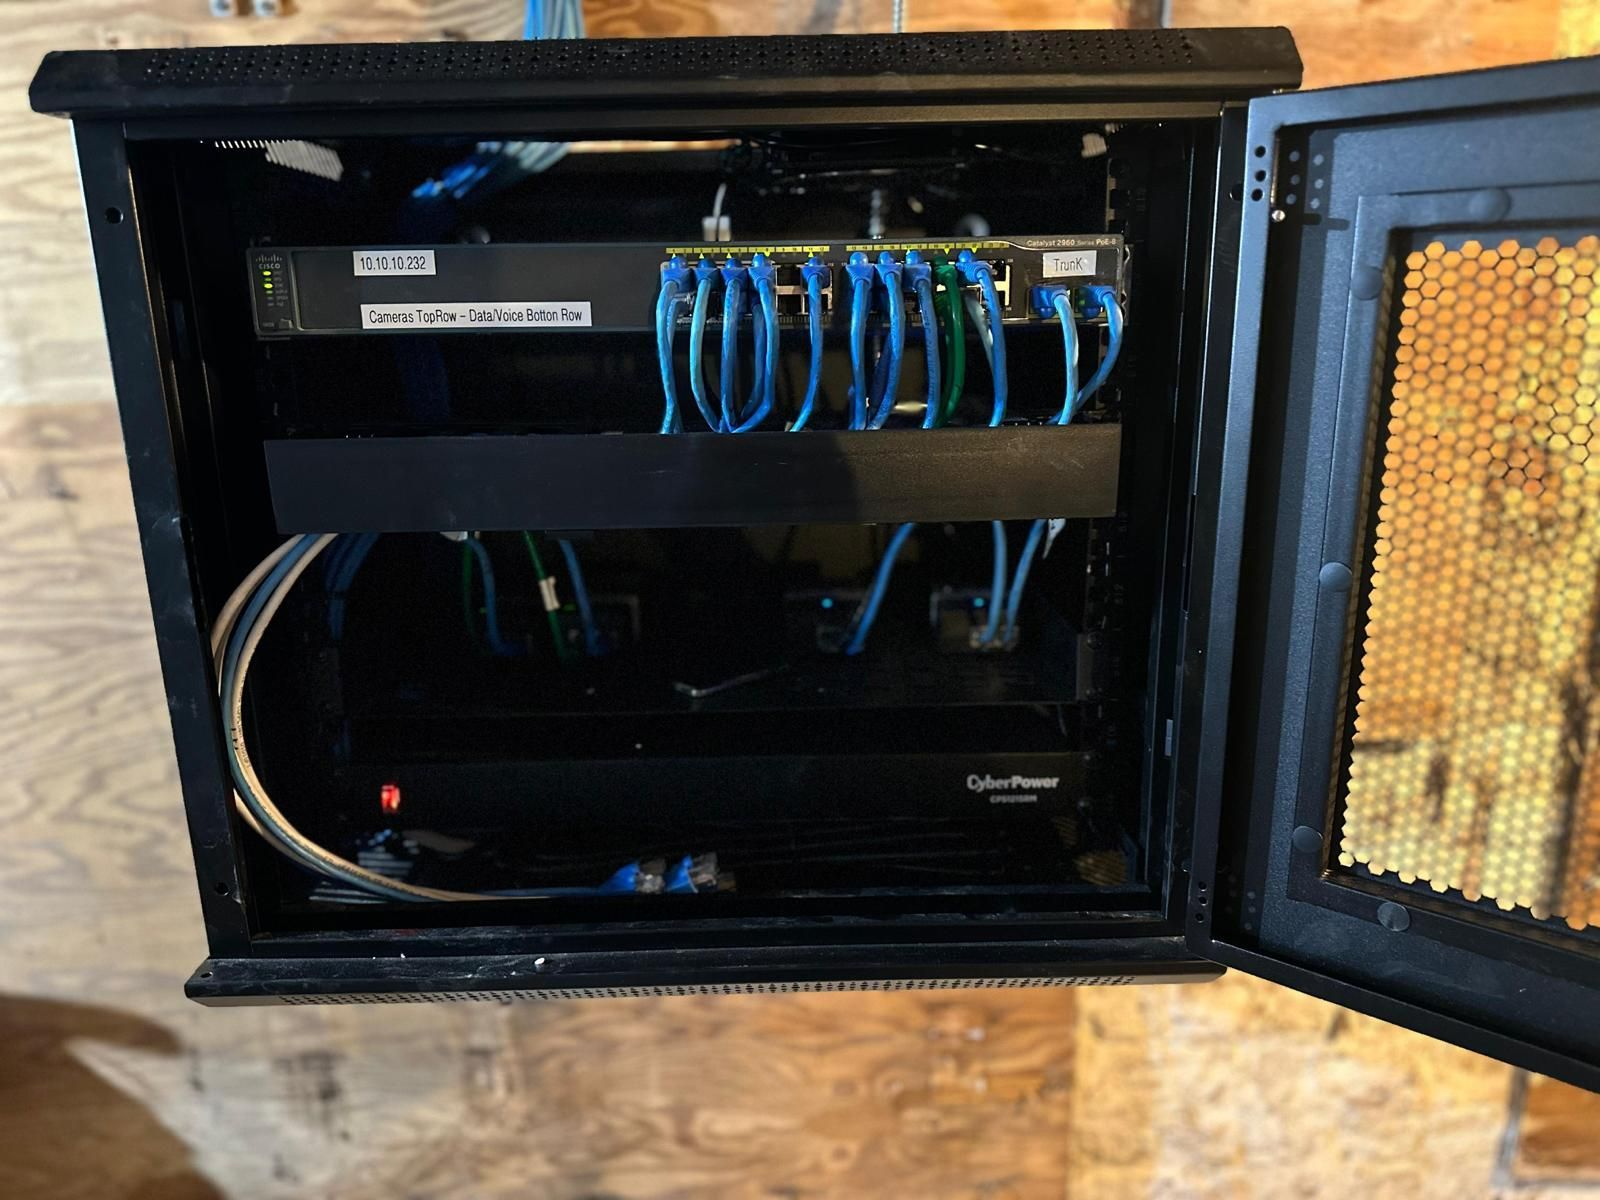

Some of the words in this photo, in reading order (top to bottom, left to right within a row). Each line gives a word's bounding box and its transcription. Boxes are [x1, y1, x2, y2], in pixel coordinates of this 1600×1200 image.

[1026, 240, 1056, 248] Catalyst
[360, 256, 426, 271] 10.10.10.232
[369, 310, 414, 324] Cameras
[416, 309, 457, 324] TopRow
[469, 308, 524, 323] Data/Voice
[527, 308, 559, 322] Botton
[561, 308, 582, 322] Row
[966, 773, 1060, 793] CyberPower
